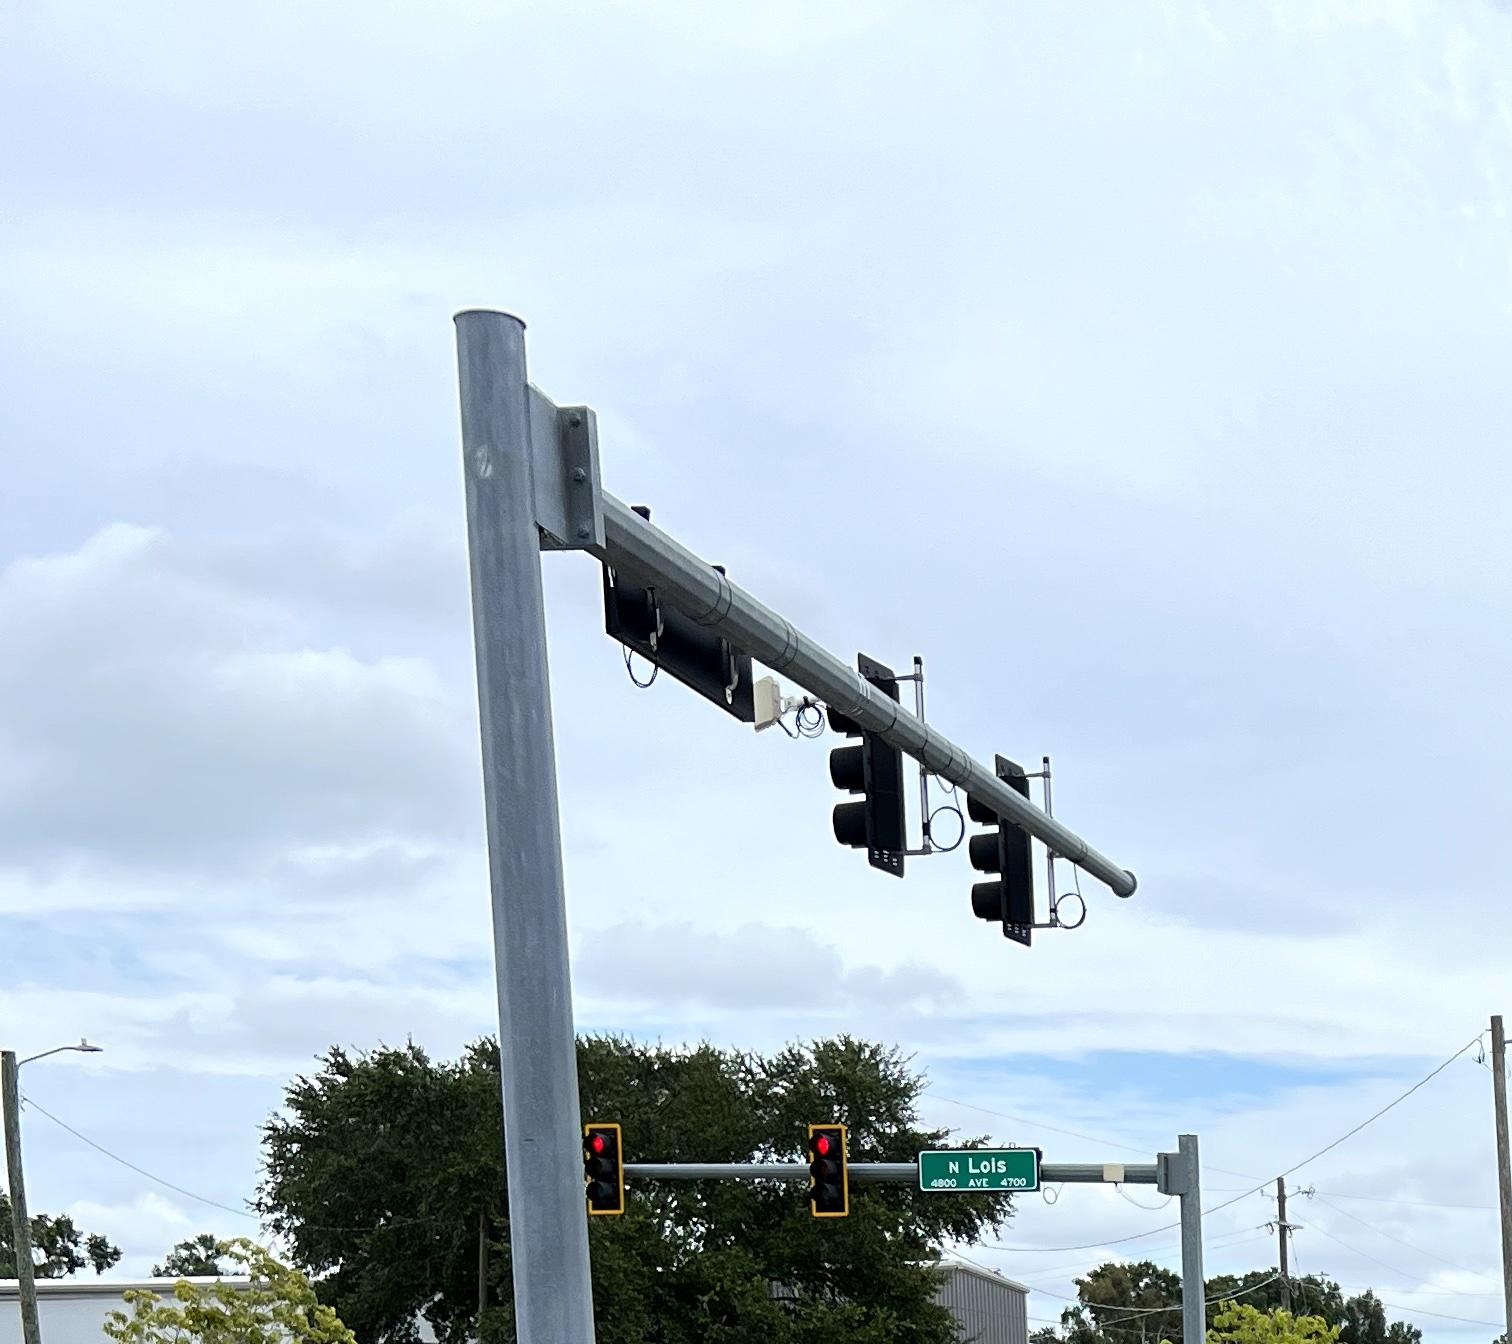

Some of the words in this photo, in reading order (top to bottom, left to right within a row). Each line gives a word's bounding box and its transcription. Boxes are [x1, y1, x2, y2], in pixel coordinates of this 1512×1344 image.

[949, 1161, 959, 1174] N
[968, 1157, 1007, 1174] Lois
[930, 1178, 957, 1188] 4800
[968, 1178, 989, 1188] AVE
[1000, 1177, 1027, 1187] 4700
